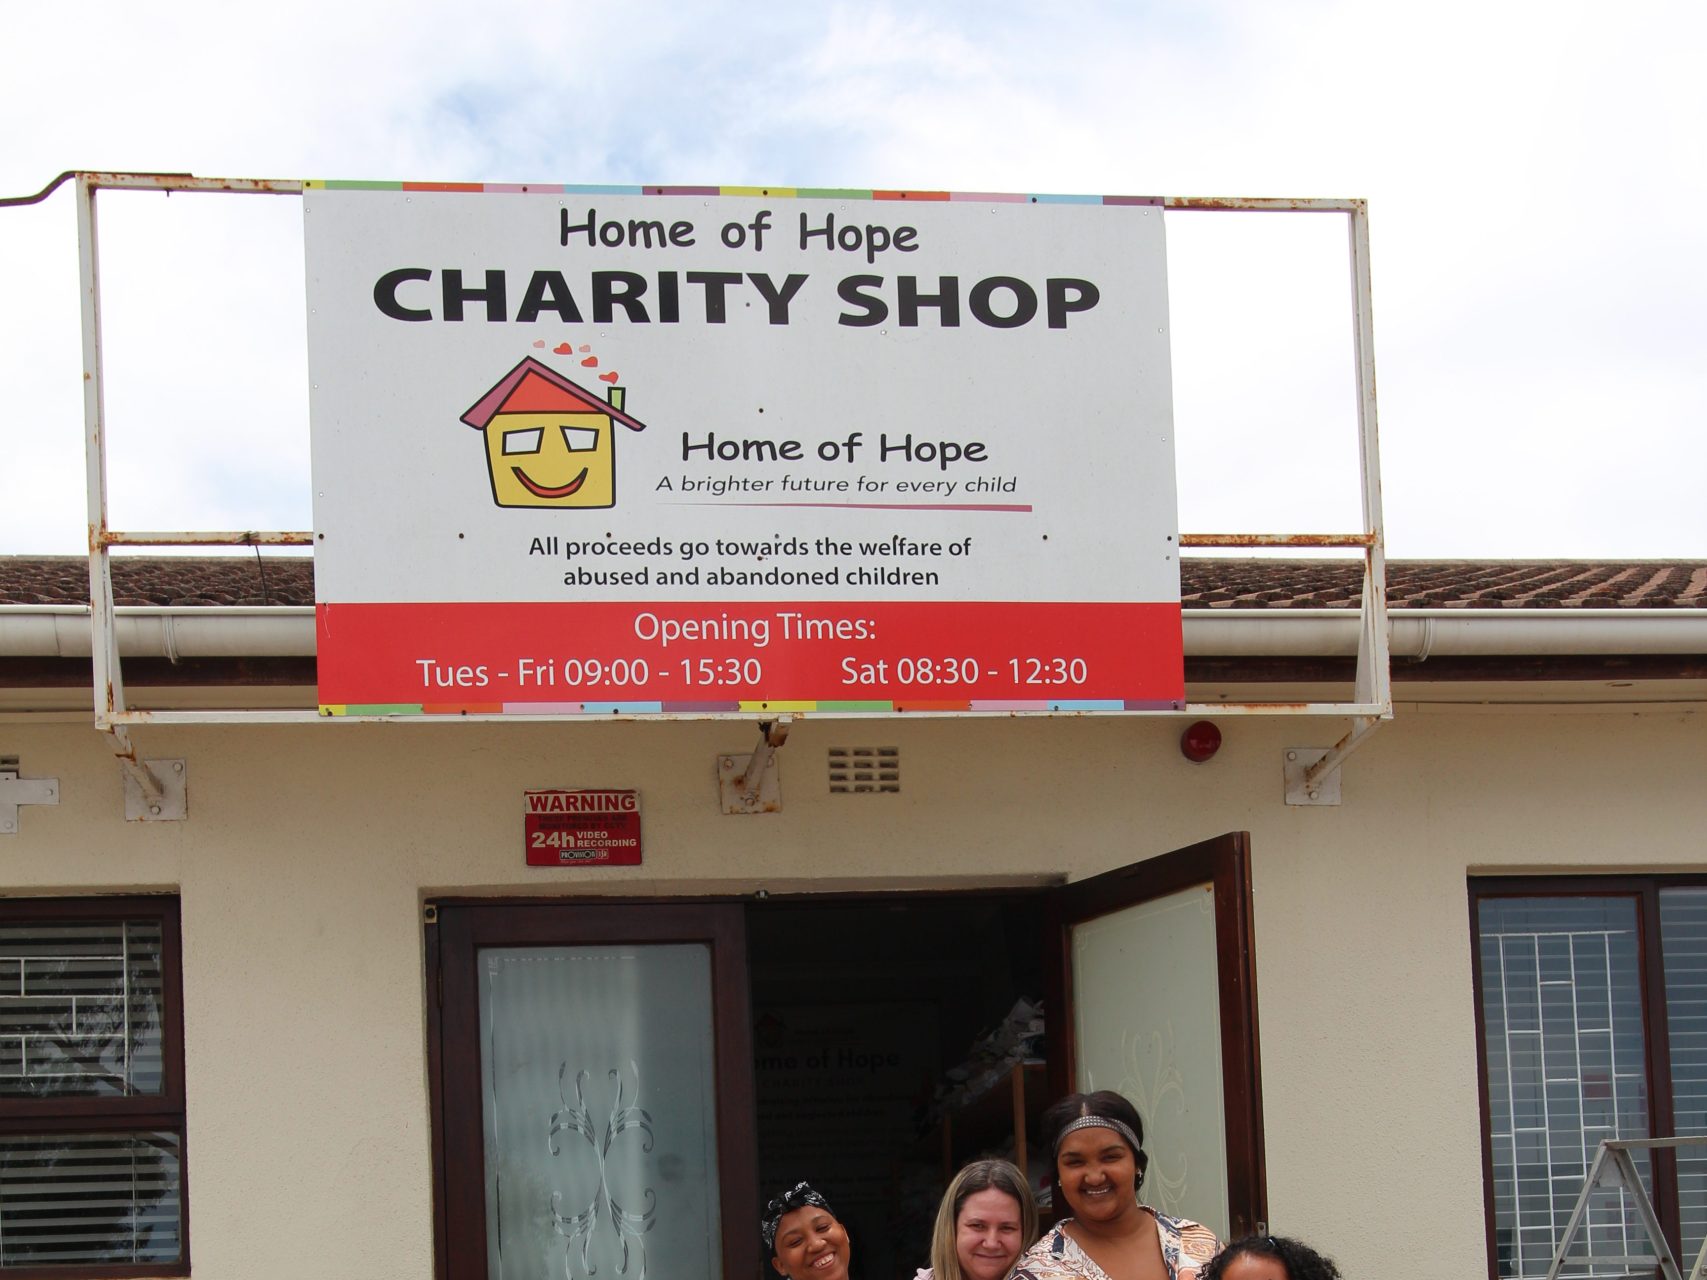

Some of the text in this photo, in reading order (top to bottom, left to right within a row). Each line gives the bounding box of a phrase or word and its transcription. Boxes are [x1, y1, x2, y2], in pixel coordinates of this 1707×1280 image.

[560, 207, 920, 264] Home of Hope
[373, 267, 1101, 329] CHARITY SHOP
[682, 431, 989, 471] Home of Hope
[655, 474, 1018, 499] A brighter future for every child
[528, 536, 972, 562] All proceeds go towards the welfare of
[563, 566, 939, 586] abused and abandoned children
[633, 612, 877, 647] Opening Times:
[415, 659, 489, 687] Tues
[518, 658, 555, 686] Fri
[564, 658, 649, 686] 09:00
[680, 658, 762, 685] 15:30
[841, 657, 889, 685] Sat
[897, 657, 979, 685] 08:30
[1009, 657, 1087, 685] 12:30
[528, 794, 636, 812] WARNING
[531, 831, 575, 849] 24h
[577, 831, 609, 839] VIDEO
[577, 839, 637, 848] RECORDING
